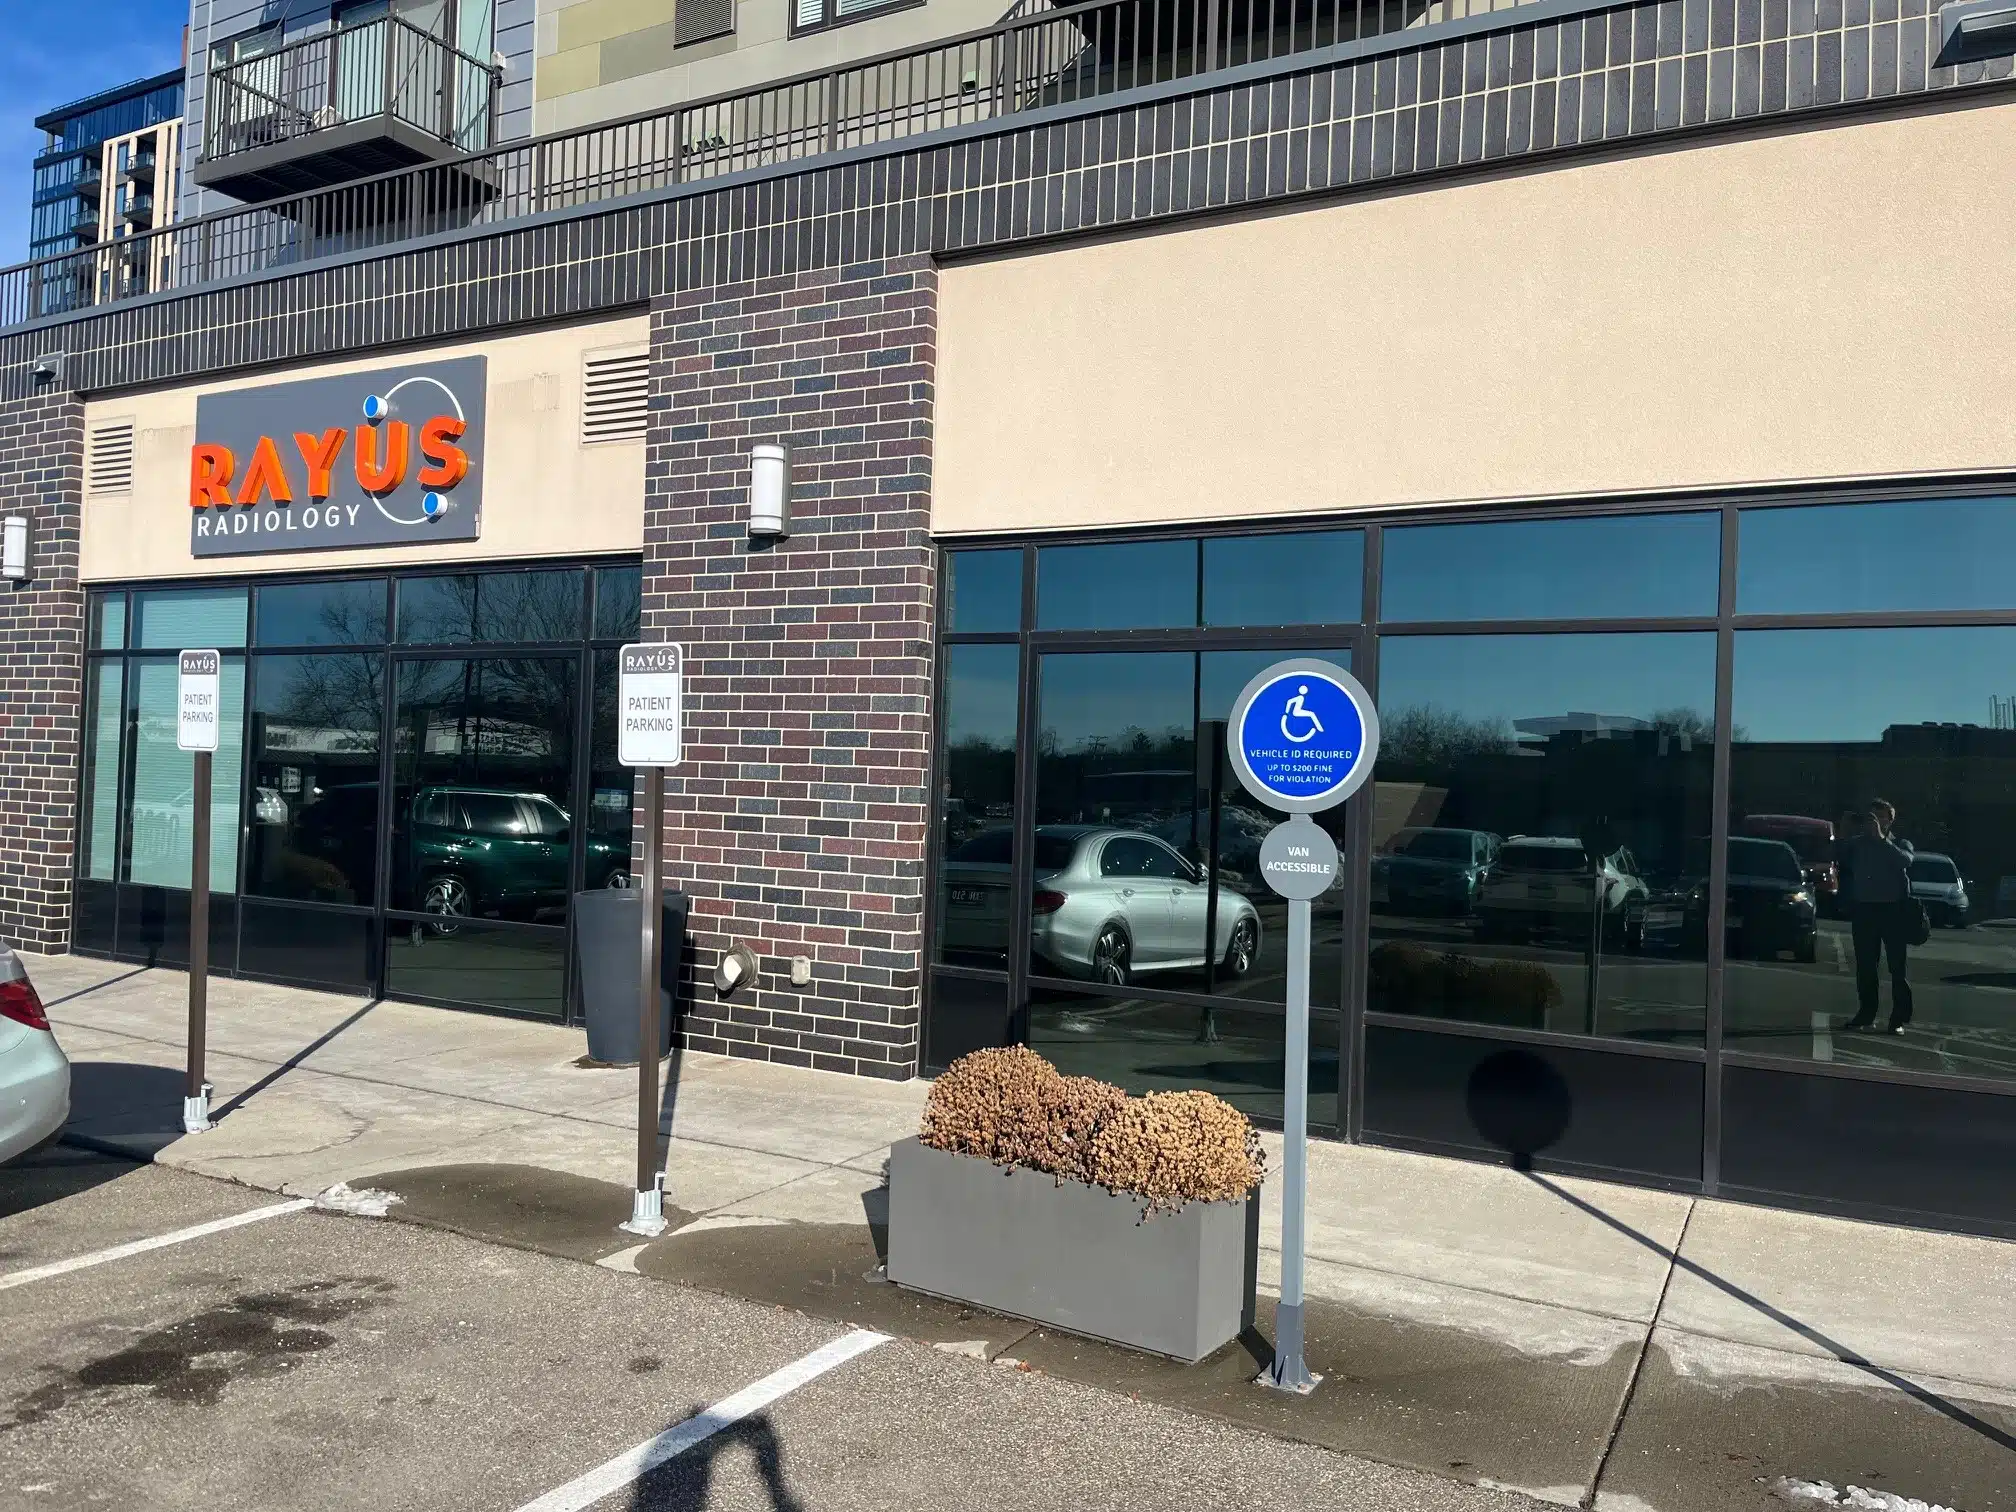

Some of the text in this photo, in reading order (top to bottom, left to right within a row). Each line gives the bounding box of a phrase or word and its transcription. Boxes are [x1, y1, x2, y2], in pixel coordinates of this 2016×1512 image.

[190, 415, 469, 508] RAYUS
[197, 504, 361, 537] RADIOLOGY
[183, 659, 215, 669] RAYUS
[626, 655, 676, 666] RAYUS
[184, 694, 212, 705] PATIENT
[628, 697, 671, 710] PATIENT
[182, 711, 214, 723] PARKING
[626, 718, 673, 731] PARKING
[1250, 749, 1353, 759] VEHICLE ID REQUIRED
[1292, 764, 1312, 772] $200
[1314, 764, 1333, 772] FINE
[1286, 775, 1331, 783] VIOLATION
[1287, 846, 1309, 857] VAN
[1266, 861, 1330, 874] ACCESSIBLE
